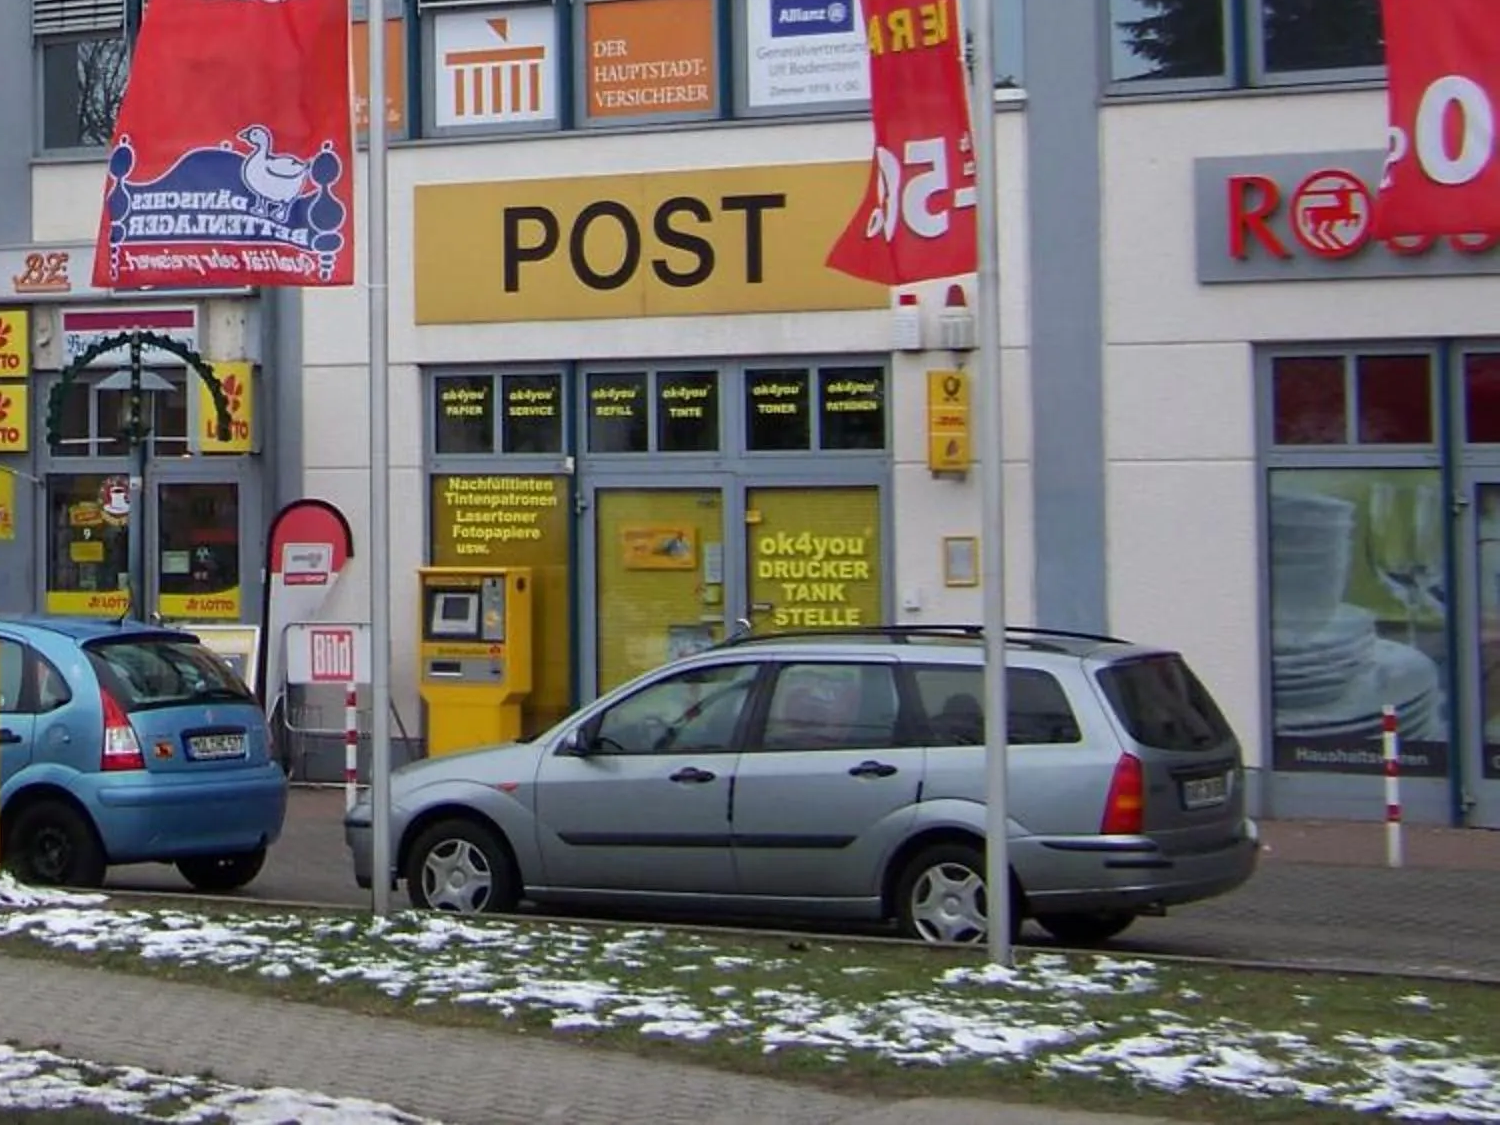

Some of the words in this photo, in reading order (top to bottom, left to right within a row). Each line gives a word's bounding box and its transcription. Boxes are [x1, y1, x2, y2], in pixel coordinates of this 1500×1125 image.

[779, 7, 827, 24] Allianz
[593, 38, 628, 58] DER
[594, 58, 707, 83] HAUPTSTADT-
[595, 83, 709, 108] VERSICHERER
[503, 193, 787, 293] POST
[446, 406, 483, 416] PAPIER
[509, 406, 554, 416] SERVICE
[595, 406, 634, 416] REFILL
[669, 406, 702, 418] TINTE
[757, 403, 797, 414] TONER
[449, 477, 554, 491] Nachfülltinten
[444, 492, 558, 508] Tintenpatronen
[456, 510, 538, 523] Lasertoner
[452, 525, 541, 541] Fotopapiere
[456, 543, 490, 555] usw.
[759, 531, 865, 561] ok4you
[758, 560, 869, 579] DRUCKER
[781, 582, 845, 602] TANK
[773, 607, 862, 626] STELLE
[313, 633, 351, 676] Bild
